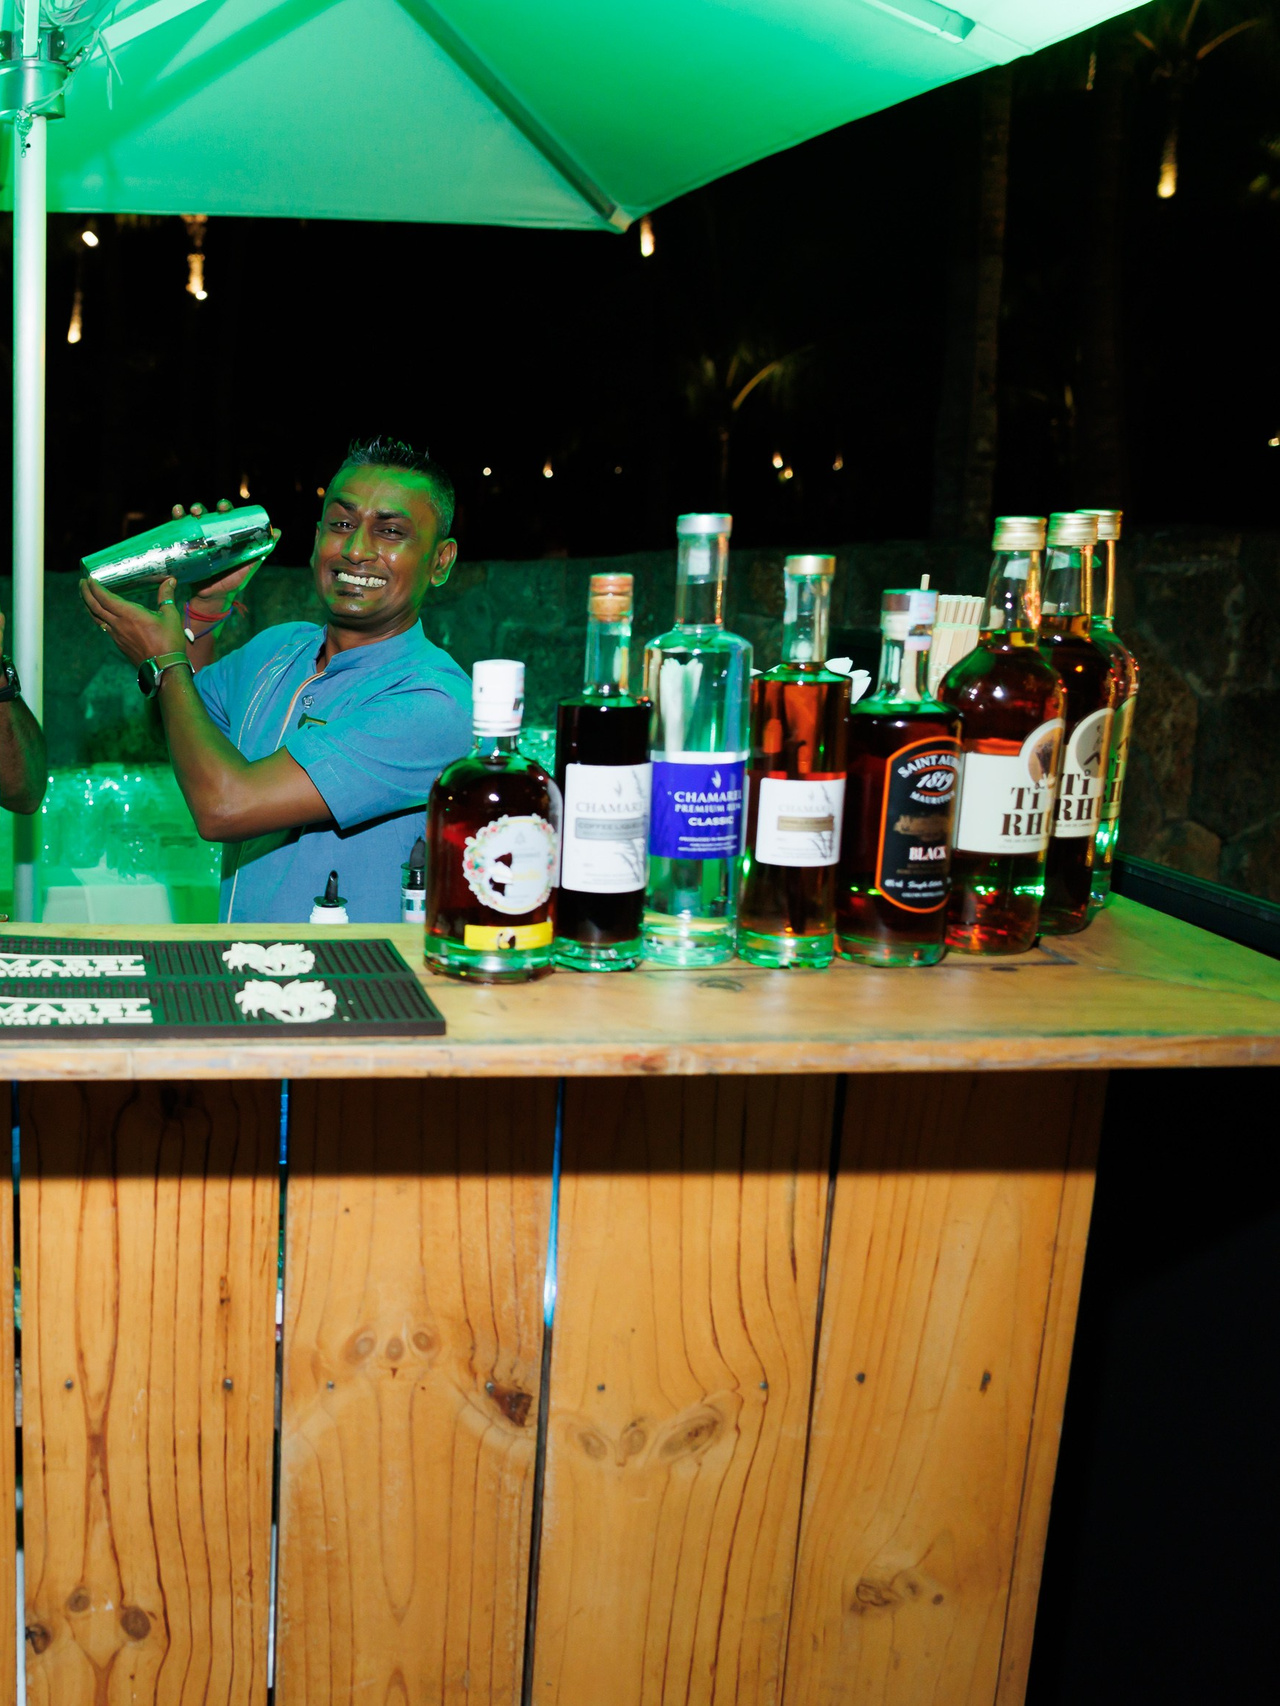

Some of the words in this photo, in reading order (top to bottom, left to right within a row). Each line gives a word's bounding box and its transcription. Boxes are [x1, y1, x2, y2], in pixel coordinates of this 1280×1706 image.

[897, 754, 939, 778] SAINT
[916, 770, 955, 792] 1819
[909, 845, 947, 861] BLACK
